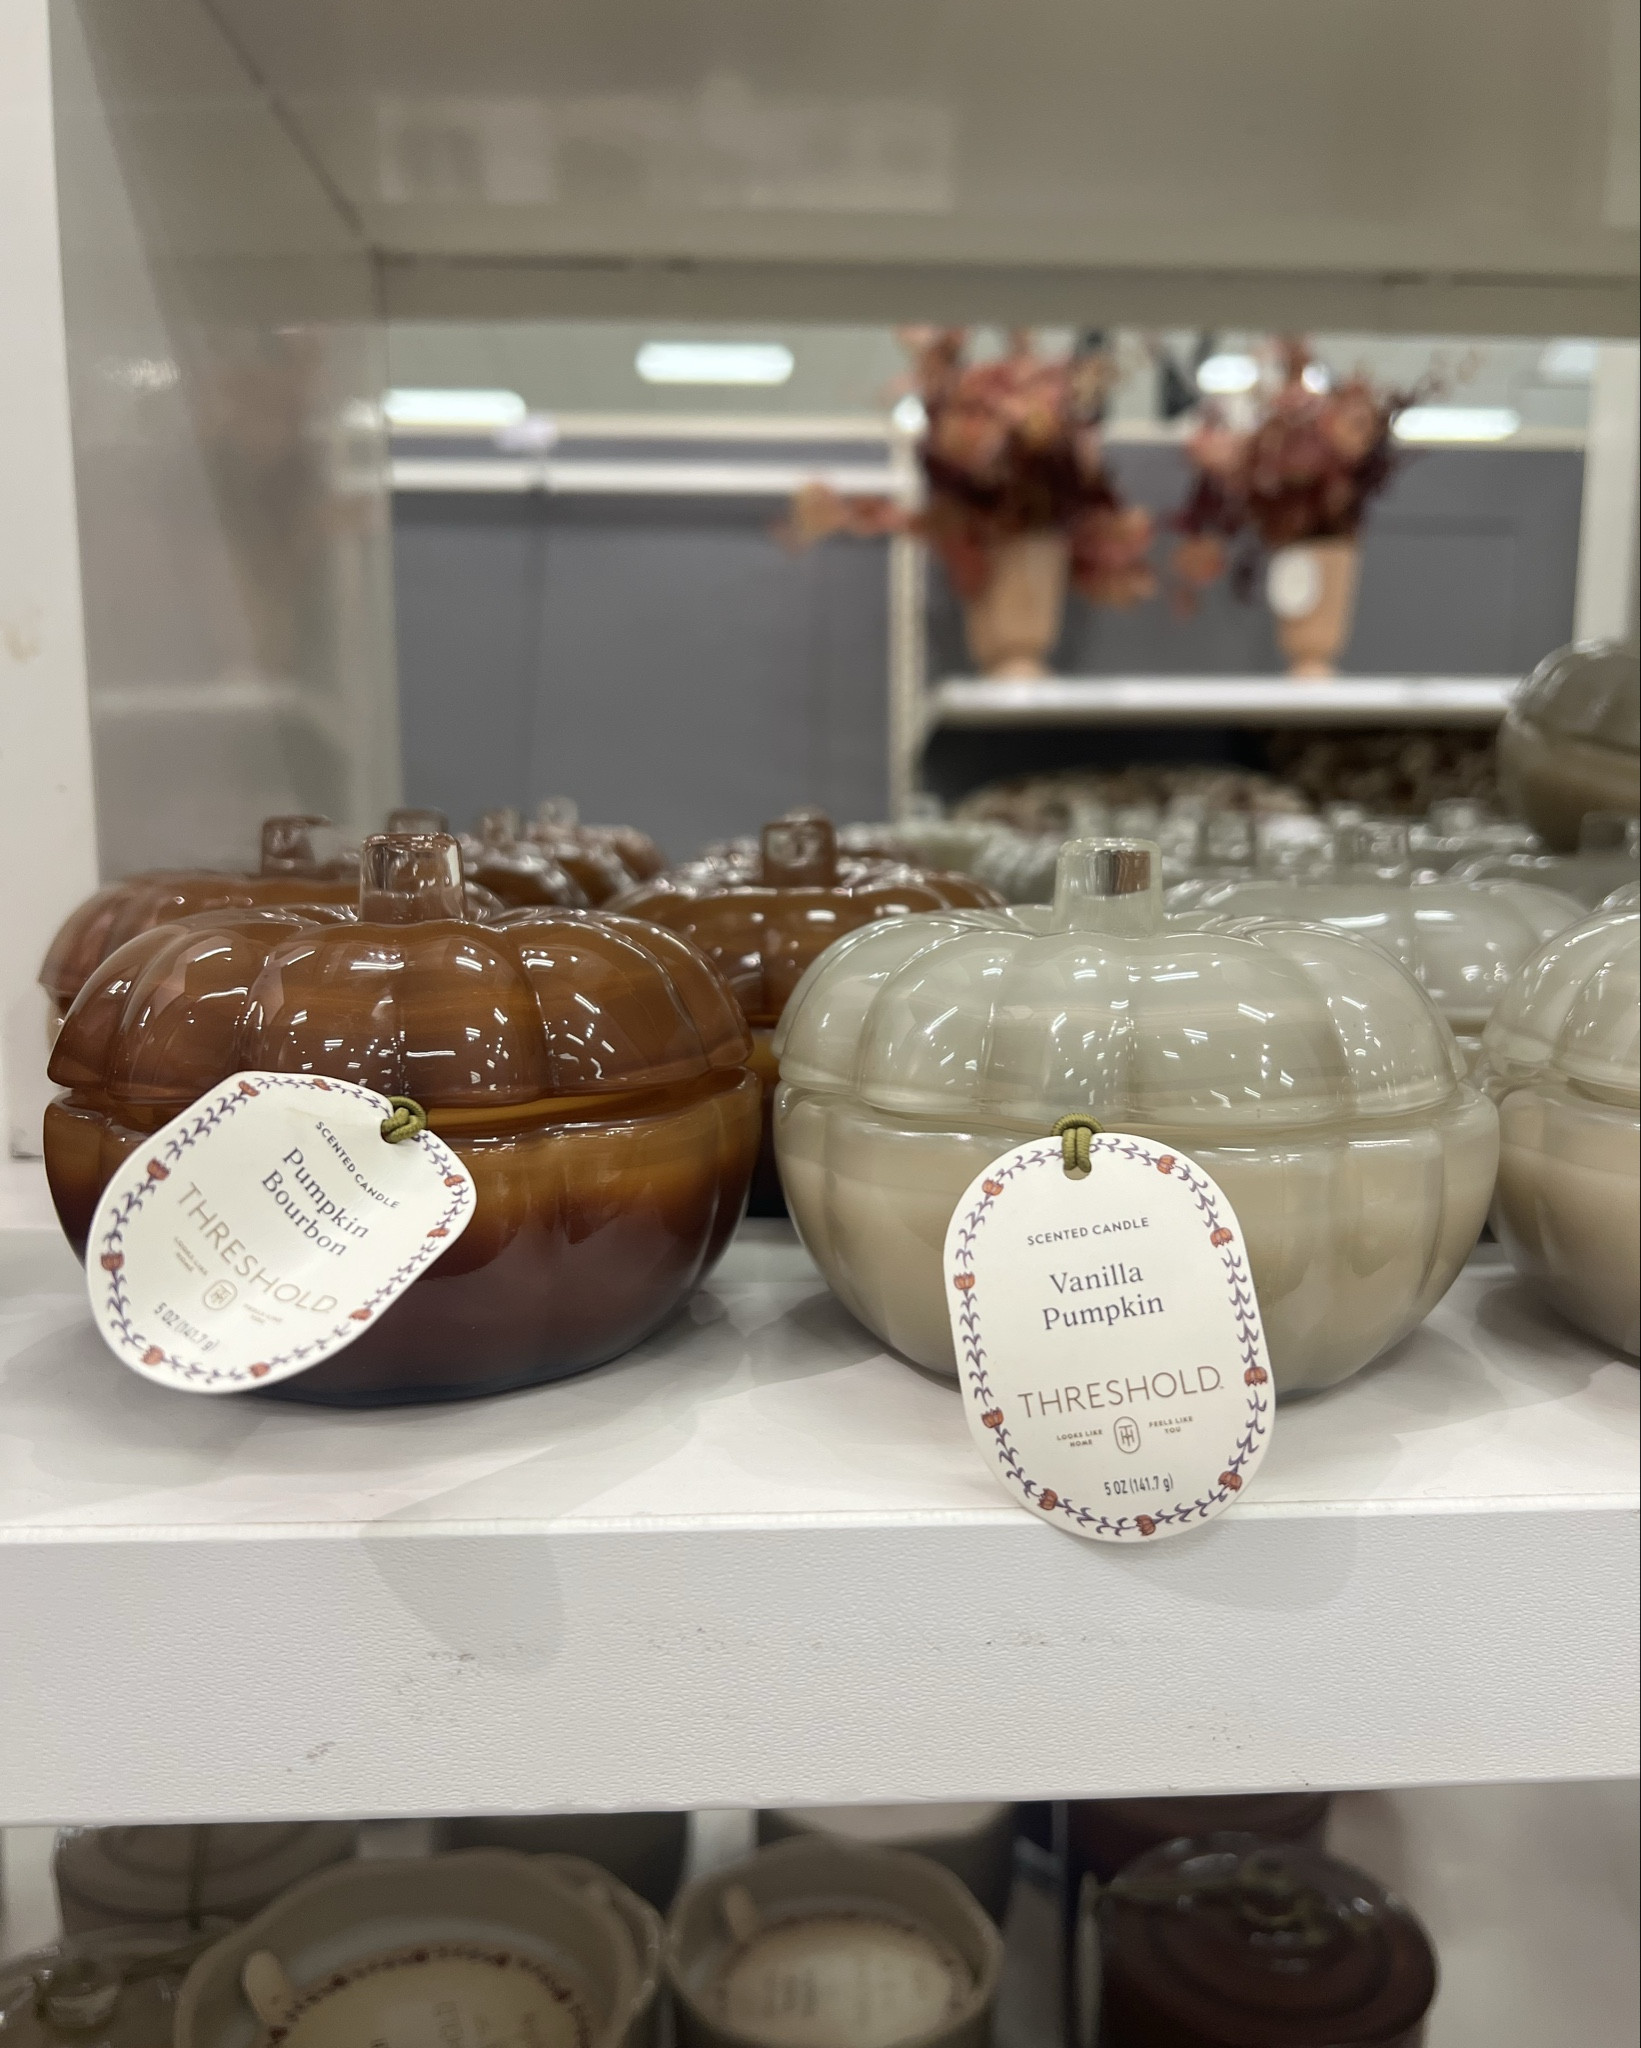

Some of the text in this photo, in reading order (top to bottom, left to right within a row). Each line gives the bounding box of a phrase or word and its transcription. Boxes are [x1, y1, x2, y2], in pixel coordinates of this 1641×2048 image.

[315, 1120, 400, 1209] SCENTED CANDLE
[283, 1145, 370, 1240] Pumpkin
[261, 1168, 348, 1256] Bourbon
[1027, 1217, 1149, 1246] SCENTED CANDLE
[177, 1181, 339, 1316] THRESHOLD
[1049, 1262, 1144, 1294] Vanilla
[154, 1301, 168, 1315] 5
[1042, 1293, 1165, 1330] Pumpkin
[1085, 1429, 1103, 1438] LIKE
[1164, 1426, 1181, 1434] YOU
[1175, 1415, 1194, 1424] LIKE
[1103, 1481, 1111, 1496] 5
[1113, 1479, 1128, 1495] OZ
